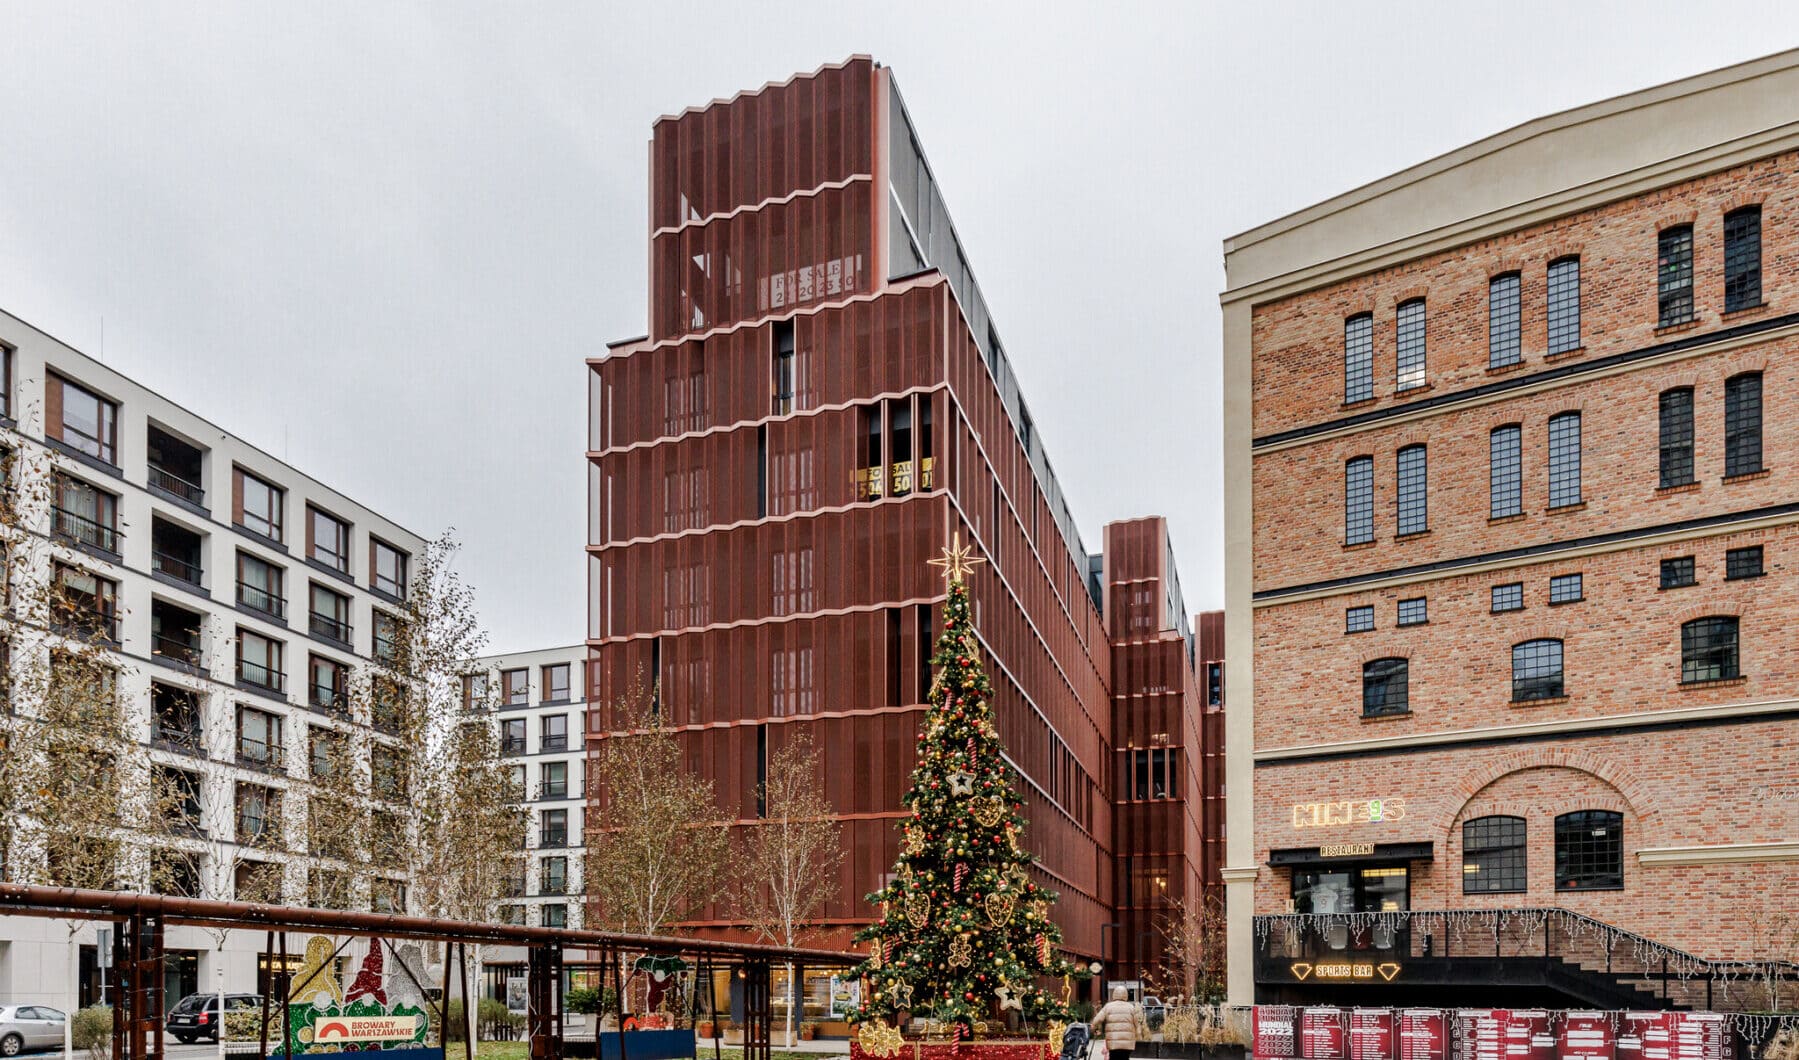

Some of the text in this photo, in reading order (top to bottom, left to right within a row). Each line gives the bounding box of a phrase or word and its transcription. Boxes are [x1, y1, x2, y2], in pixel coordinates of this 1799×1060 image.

[867, 463, 912, 478] FO SAL
[1320, 843, 1374, 857] RESTAURANT
[1316, 964, 1373, 977] SPORTS BAR
[351, 1021, 396, 1030] BROWARY
[351, 1028, 413, 1037] WARSZAWSKIE
